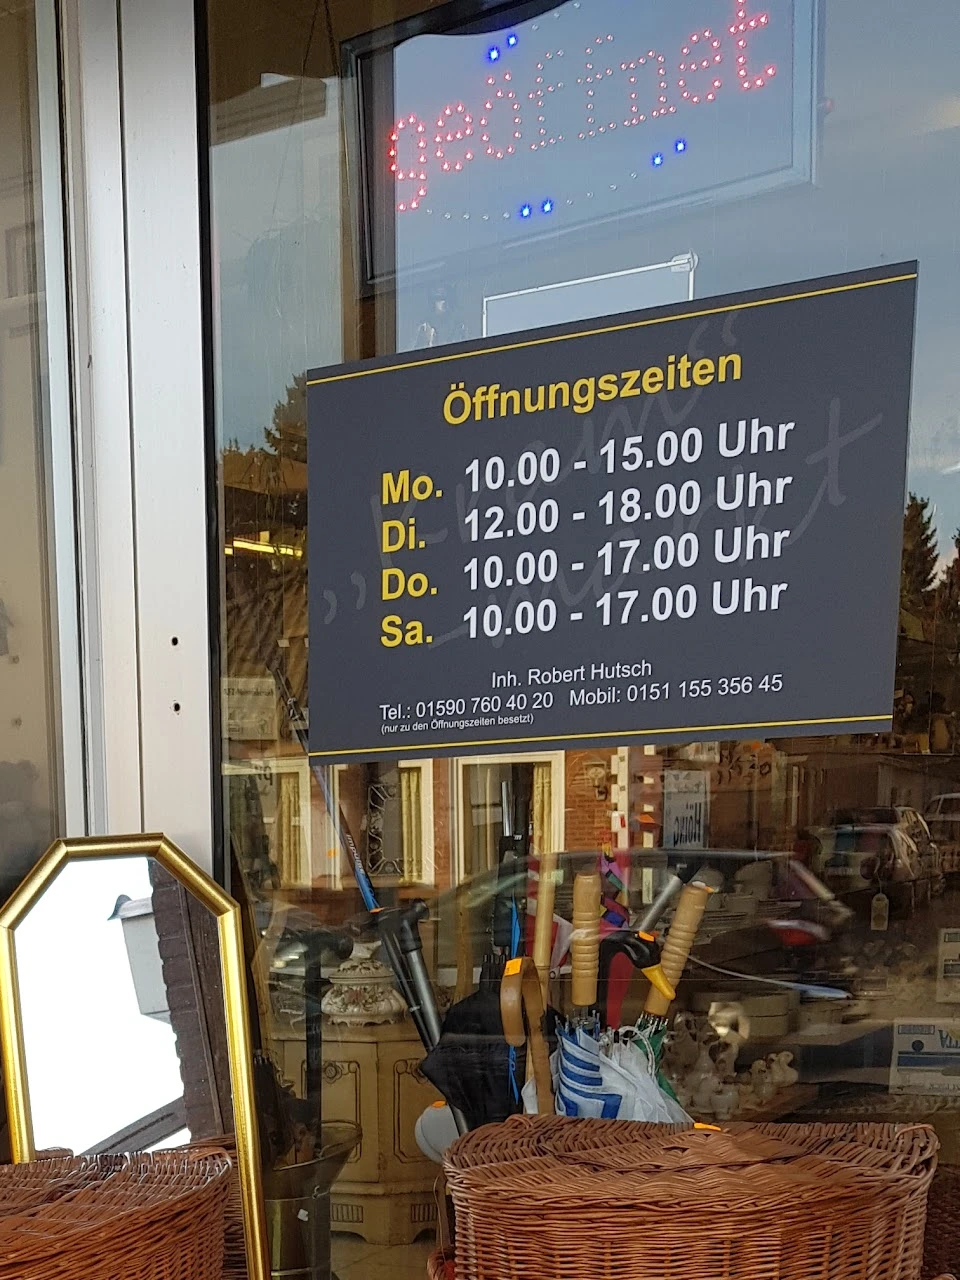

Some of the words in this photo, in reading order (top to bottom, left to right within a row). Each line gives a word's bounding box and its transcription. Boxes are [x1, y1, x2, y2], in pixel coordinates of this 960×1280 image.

[442, 350, 743, 425] Öffnungszeiten
[381, 469, 443, 505] Mo.
[464, 447, 561, 493] 10.00
[573, 460, 587, 470] -
[599, 427, 703, 474] 15.00
[718, 417, 796, 458] Uhr
[381, 517, 426, 553] Di.
[464, 498, 559, 542] 12.00
[572, 511, 586, 521] -
[598, 479, 702, 526] 18.00
[716, 471, 794, 511] Uhr
[381, 567, 438, 601] Do.
[463, 548, 558, 591] 10.00
[571, 562, 585, 571] -
[597, 532, 700, 576] 17.00
[714, 524, 792, 564] Uhr
[380, 614, 434, 648] Sa.
[462, 598, 557, 639] 10.00
[570, 612, 584, 621] -
[596, 584, 698, 626] 17.00
[712, 577, 790, 615] Uhr
[379, 703, 411, 721] Tel.:
[415, 698, 466, 718] 01590
[470, 695, 502, 714] 760
[505, 692, 527, 711] 40
[531, 691, 554, 709] 20
[569, 686, 621, 706] Mobil:
[626, 682, 670, 702] 0151
[678, 679, 712, 699] 155
[717, 676, 753, 696] 356
[758, 673, 784, 692] 45
[492, 670, 522, 689] Inh.
[528, 665, 586, 686] Robert
[590, 659, 653, 681] Hutsch
[381, 724, 398, 736] (nur
[400, 724, 410, 732] zu
[412, 721, 429, 731] den
[430, 715, 496, 731] Öffnungszeiten
[497, 713, 534, 727] besetzt)
